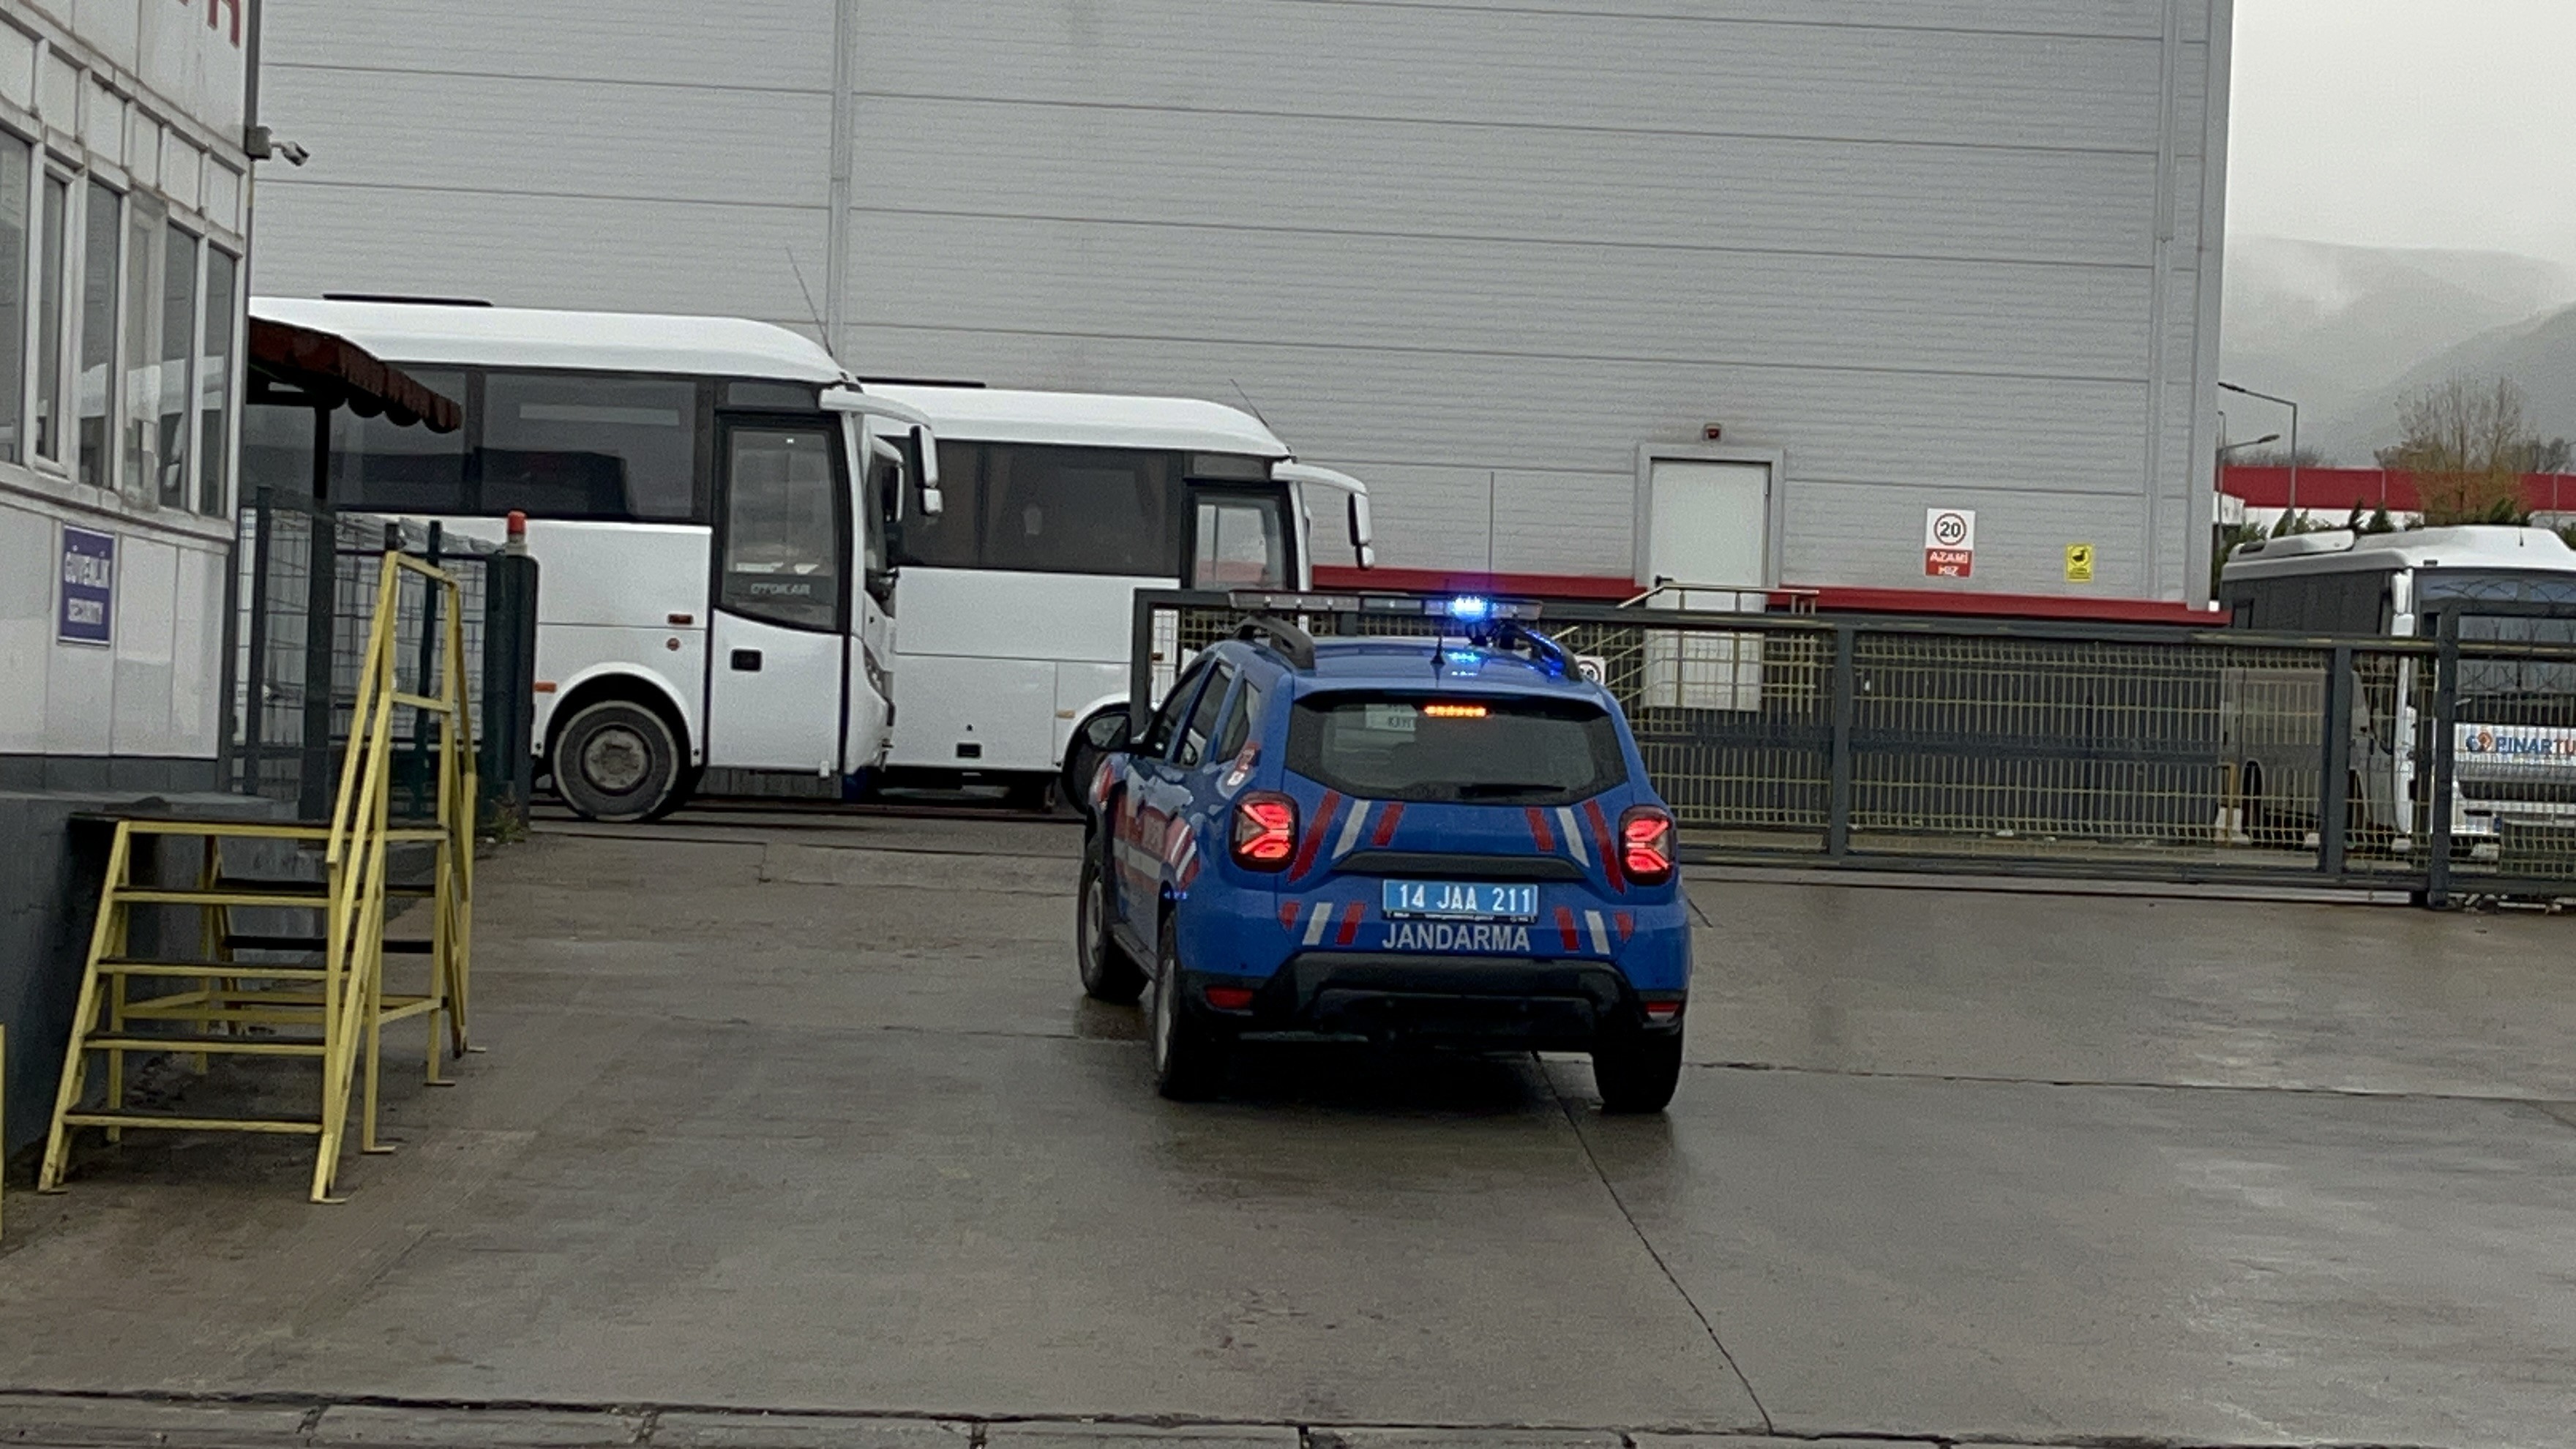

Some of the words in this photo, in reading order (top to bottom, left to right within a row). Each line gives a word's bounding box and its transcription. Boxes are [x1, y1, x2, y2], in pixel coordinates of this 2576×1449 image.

[1939, 520, 1961, 538] 20
[1400, 884, 1425, 908] 14
[1437, 886, 1478, 910] JAA
[1492, 887, 1530, 913] 211
[1382, 923, 1531, 951] JANDARMA
